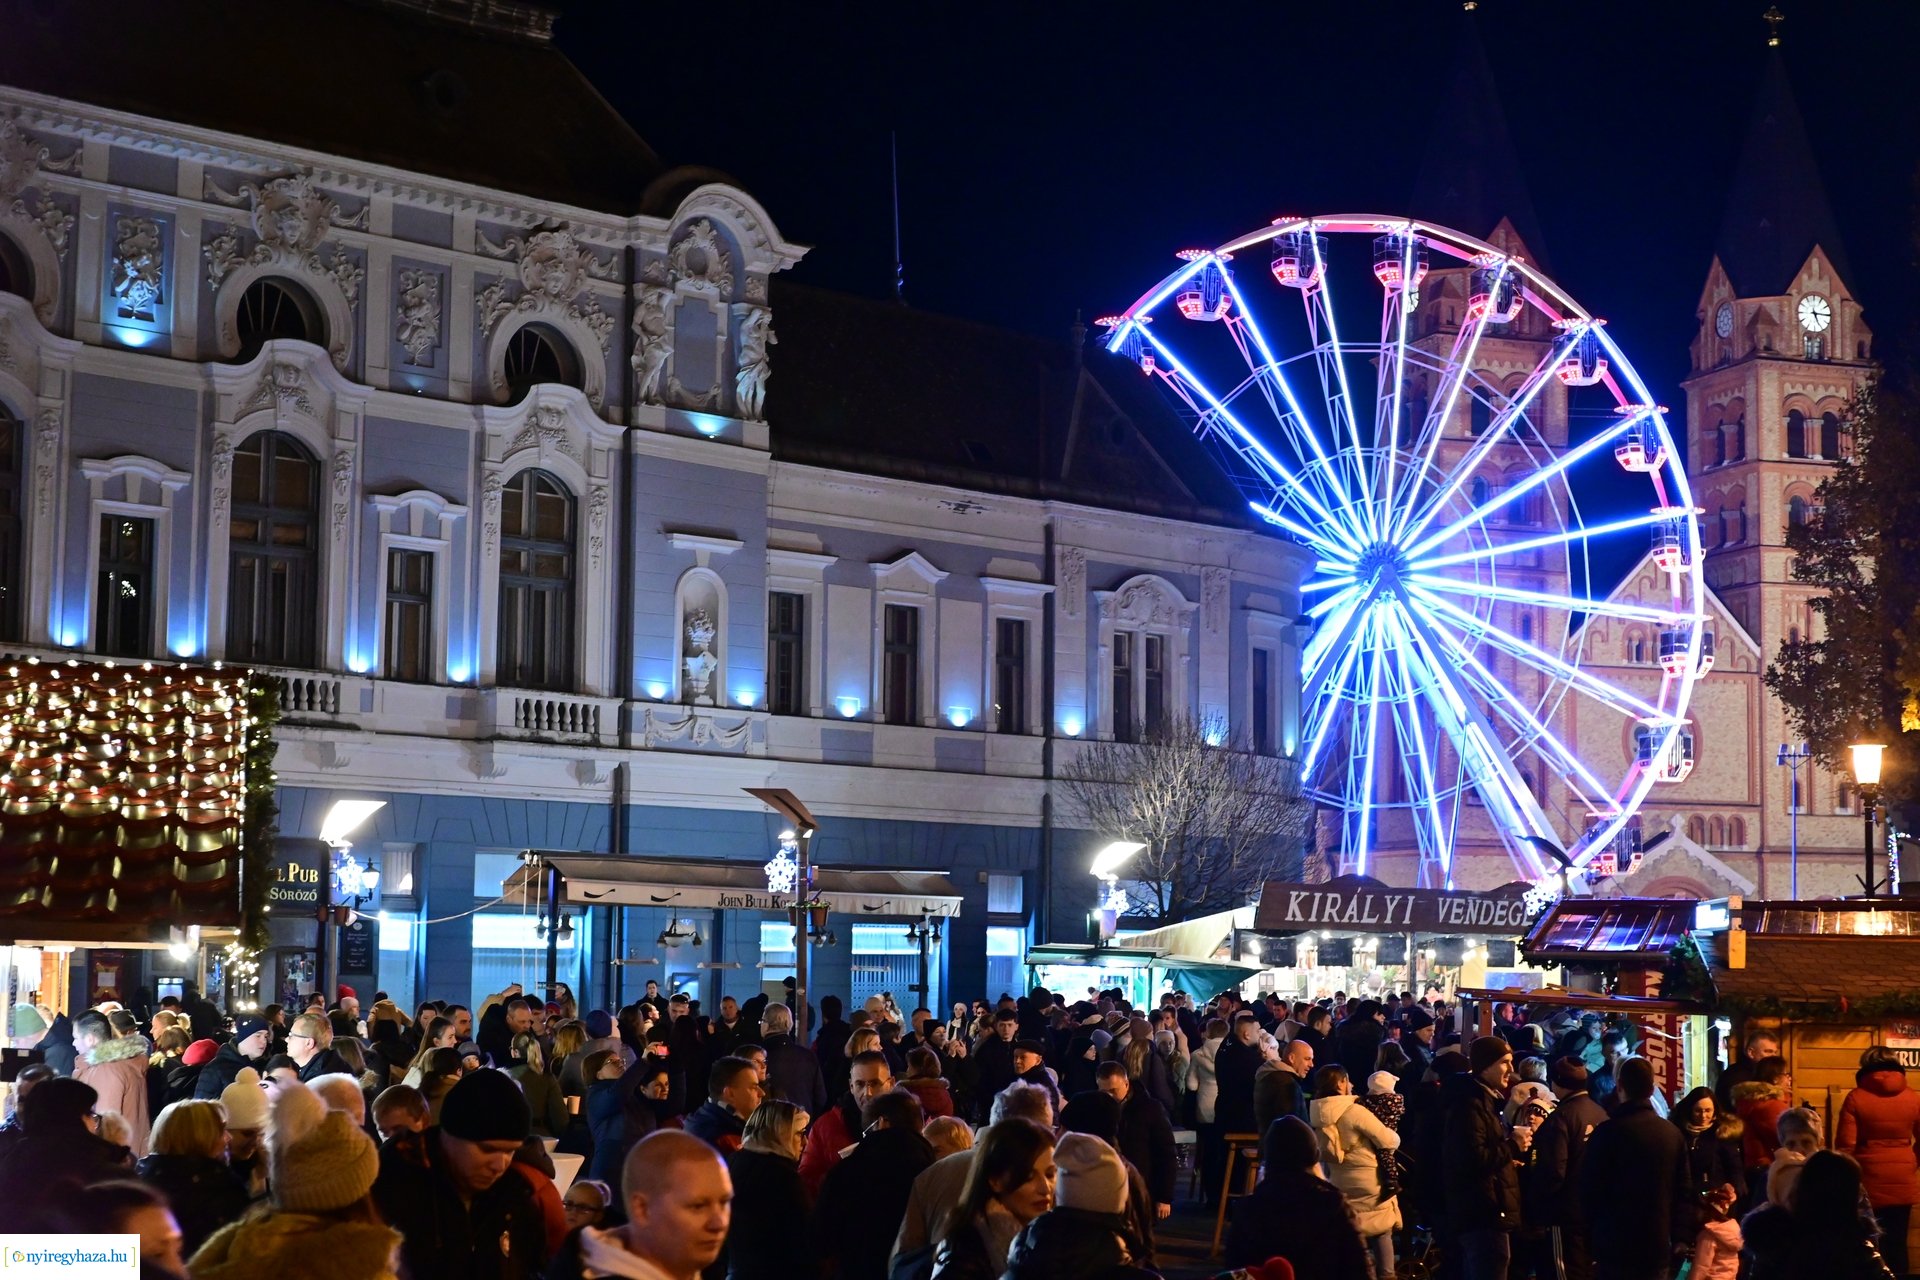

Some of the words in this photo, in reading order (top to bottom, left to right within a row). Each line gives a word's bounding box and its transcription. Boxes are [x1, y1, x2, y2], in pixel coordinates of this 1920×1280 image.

[288, 863, 319, 883] PUB
[269, 887, 318, 902] SÖRÖZŐ
[718, 893, 744, 907] JOHN
[745, 894, 770, 908] BULL
[1284, 887, 1416, 925] KIRÁLYI
